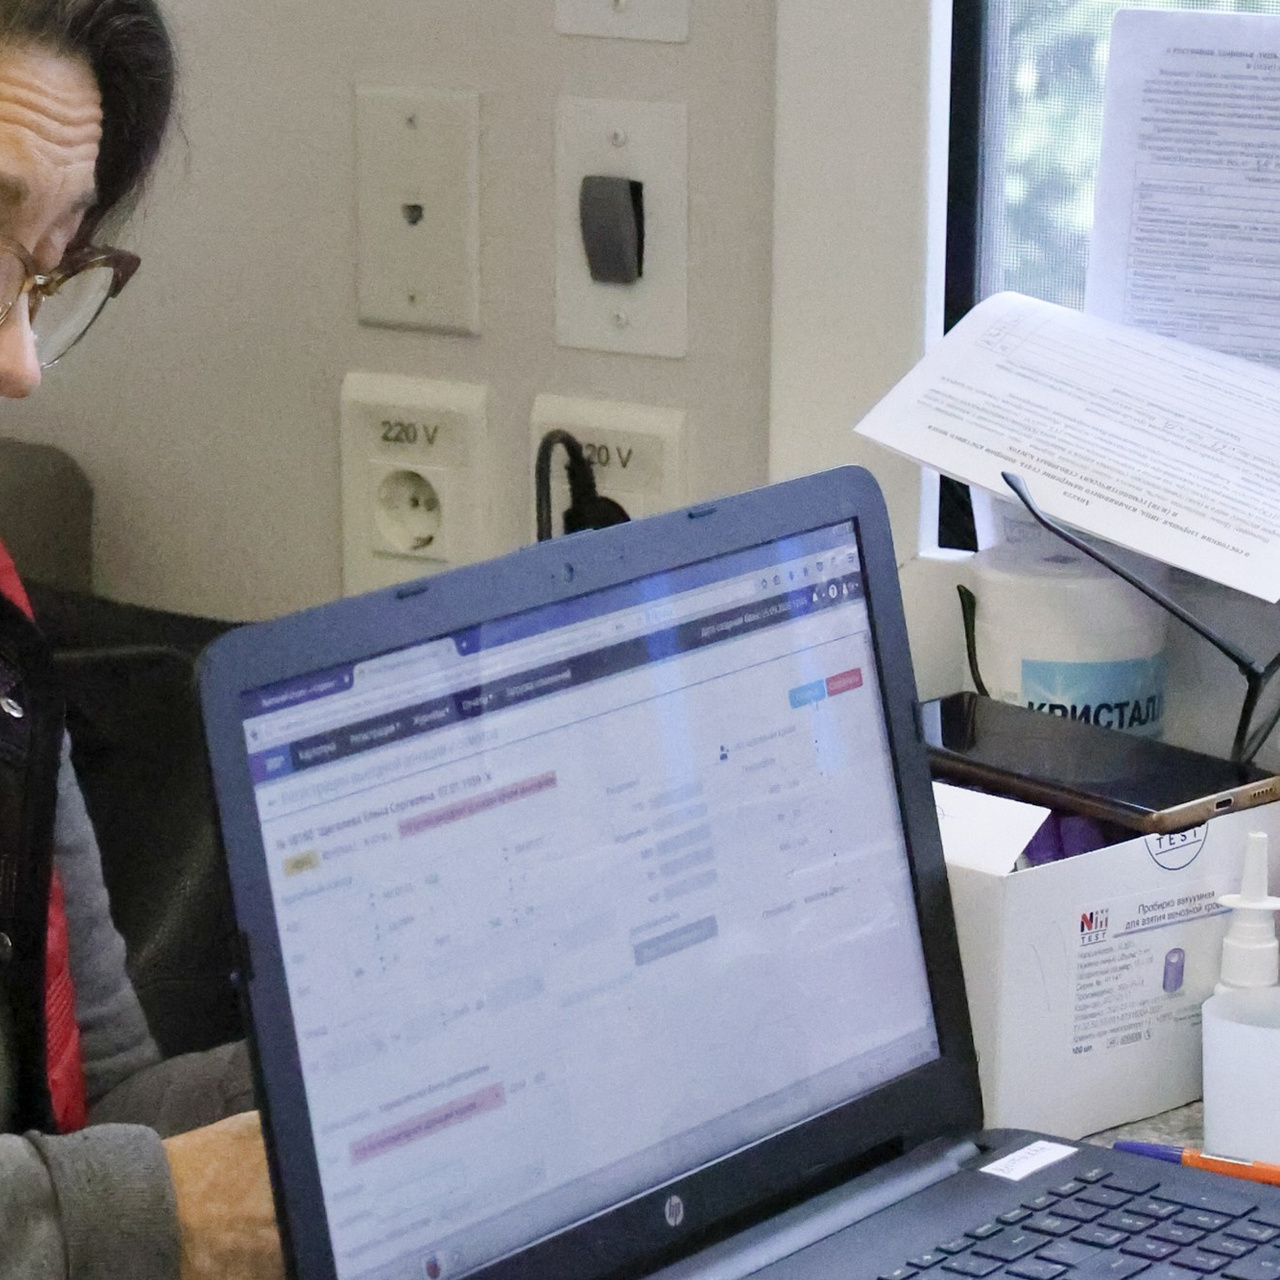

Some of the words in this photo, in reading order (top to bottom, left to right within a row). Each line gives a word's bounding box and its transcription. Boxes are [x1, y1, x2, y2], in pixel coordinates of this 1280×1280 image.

[381, 420, 417, 444] 220
[422, 424, 439, 445] V
[584, 443, 610, 467] 20
[616, 445, 633, 468] V
[1125, 919, 1140, 930] для
[1141, 913, 1166, 927] взятия
[1204, 901, 1224, 913] кров
[1081, 931, 1107, 944] TEST
[666, 1195, 683, 1227] hp
